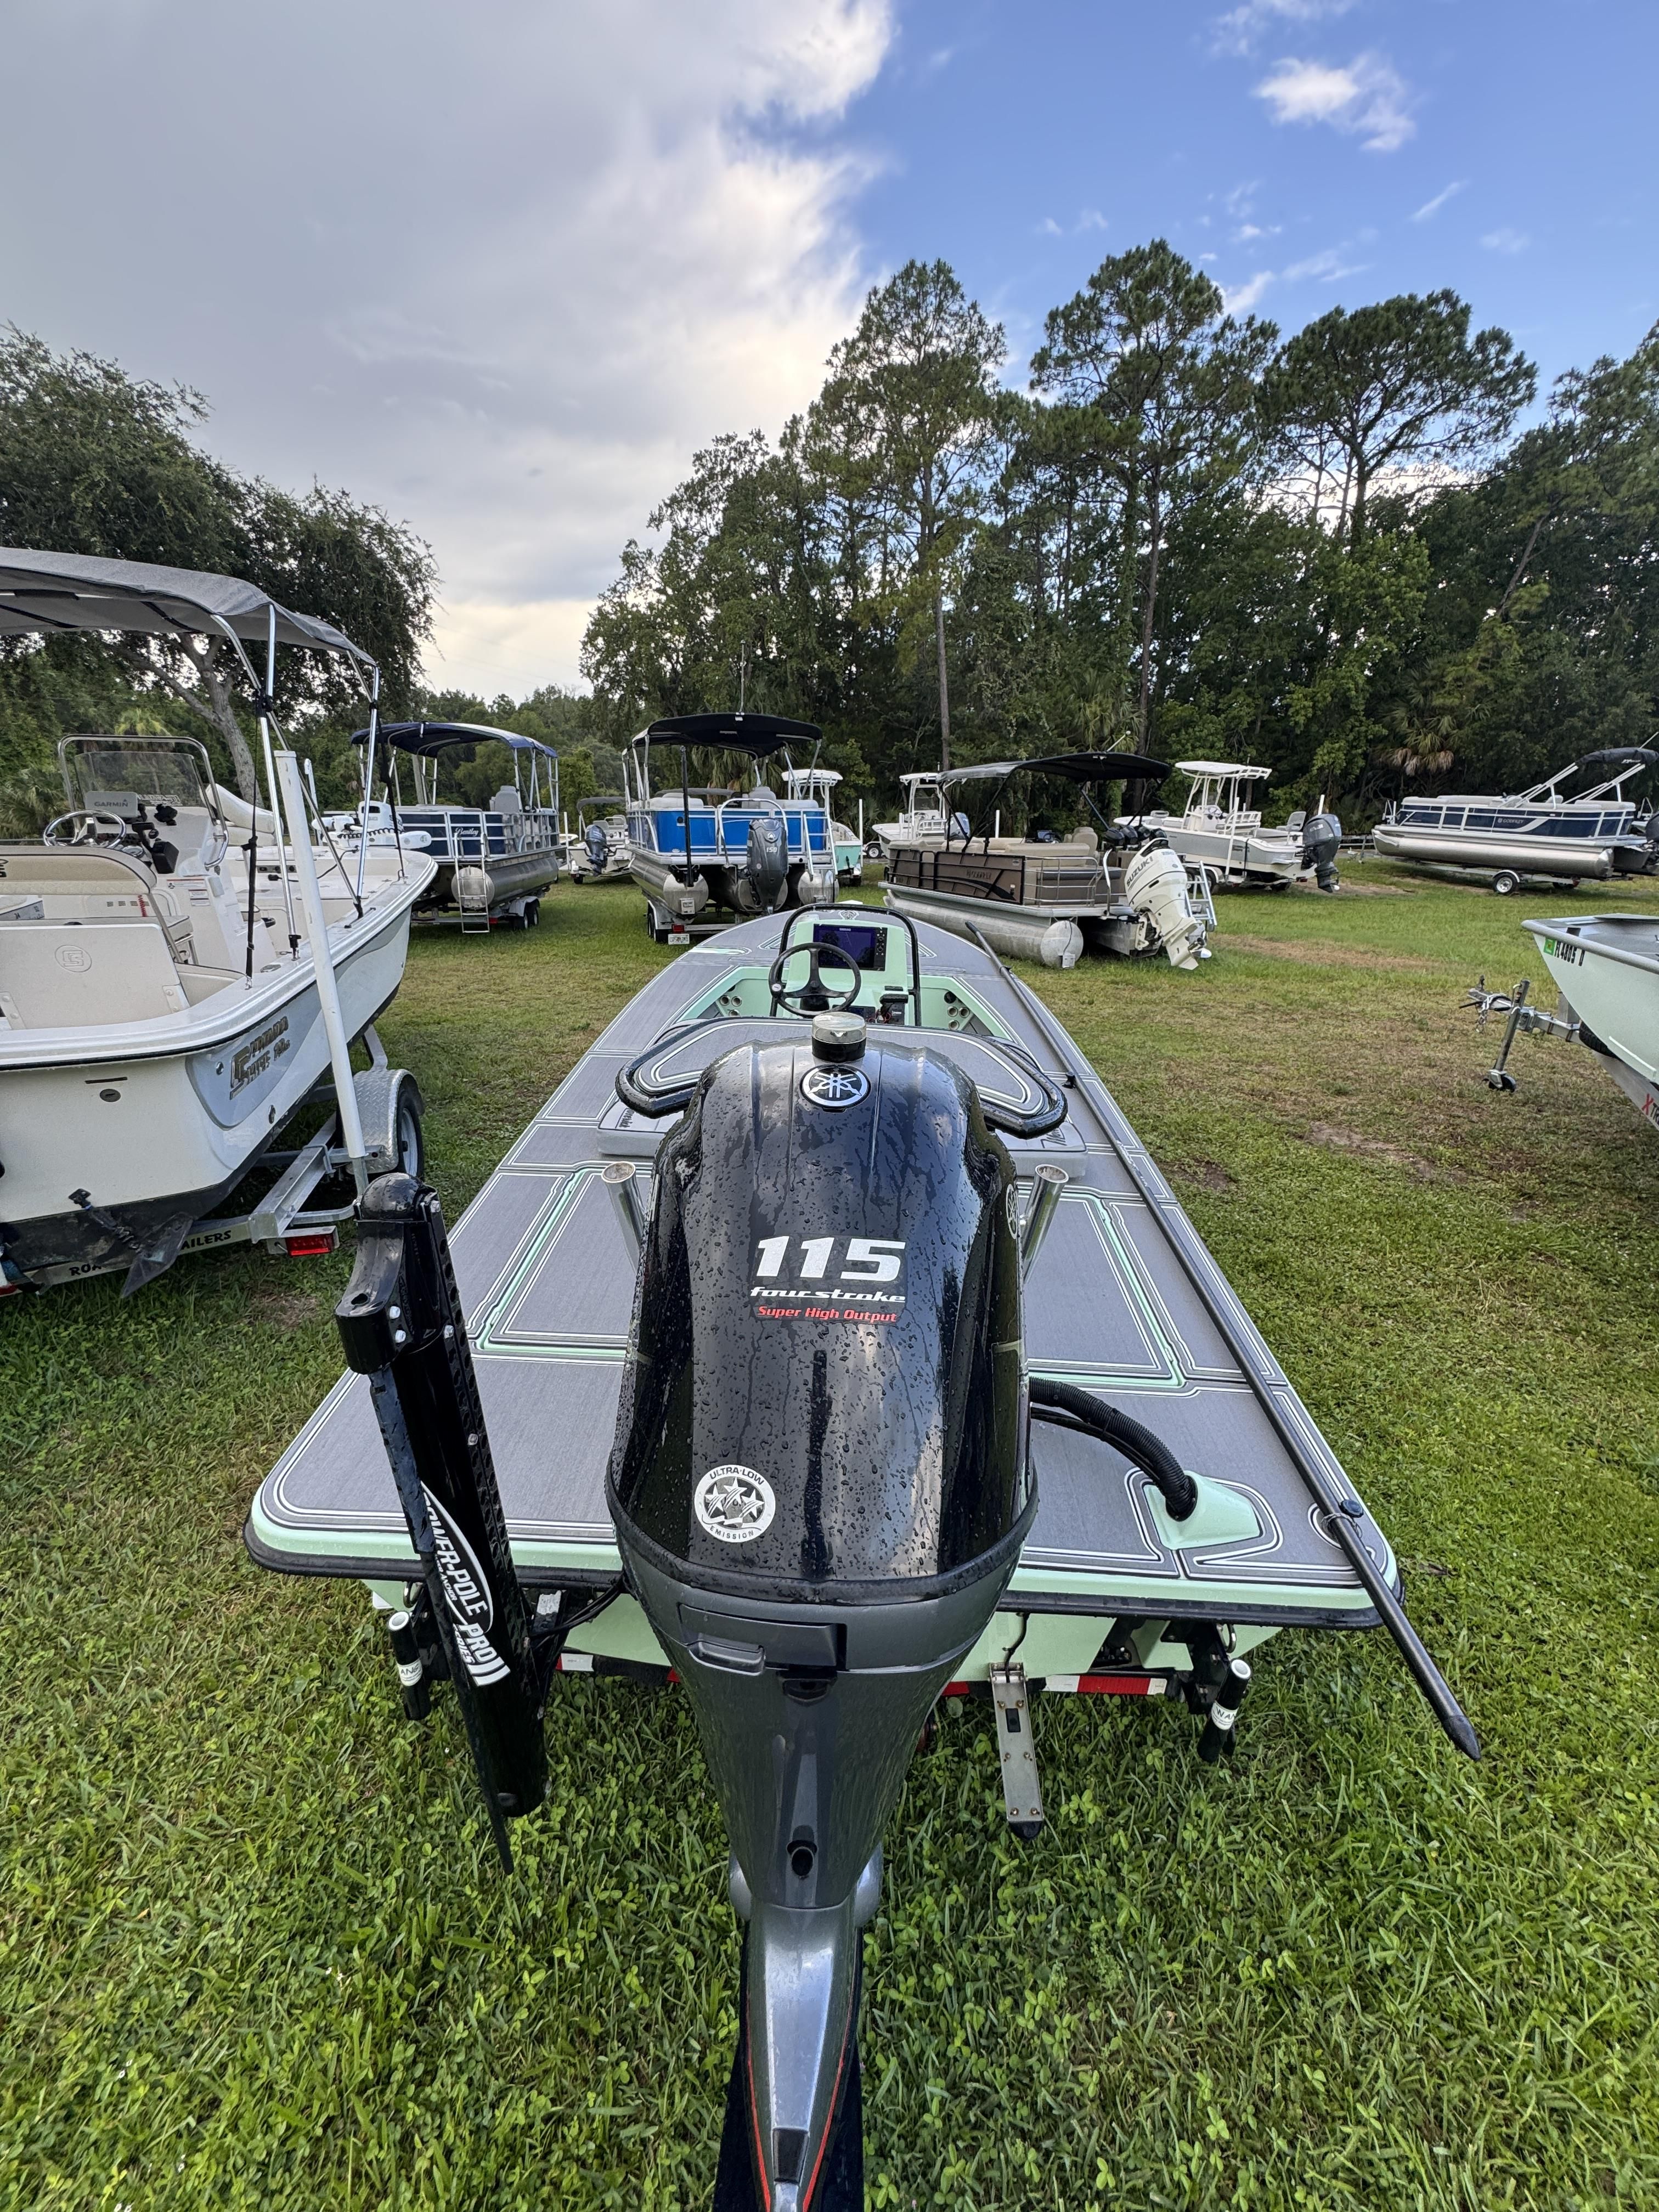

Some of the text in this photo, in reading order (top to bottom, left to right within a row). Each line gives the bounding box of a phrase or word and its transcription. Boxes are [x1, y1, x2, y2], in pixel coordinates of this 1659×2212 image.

[455, 827, 479, 837] Bentley
[1126, 856, 1153, 887] SUZUKI
[756, 1235, 906, 1282] 115
[757, 1305, 897, 1323] Super High Output
[709, 1525, 754, 1539] EMISSION
[440, 1572, 458, 1601] ANCHOR
[456, 1622, 498, 1663] PRO
